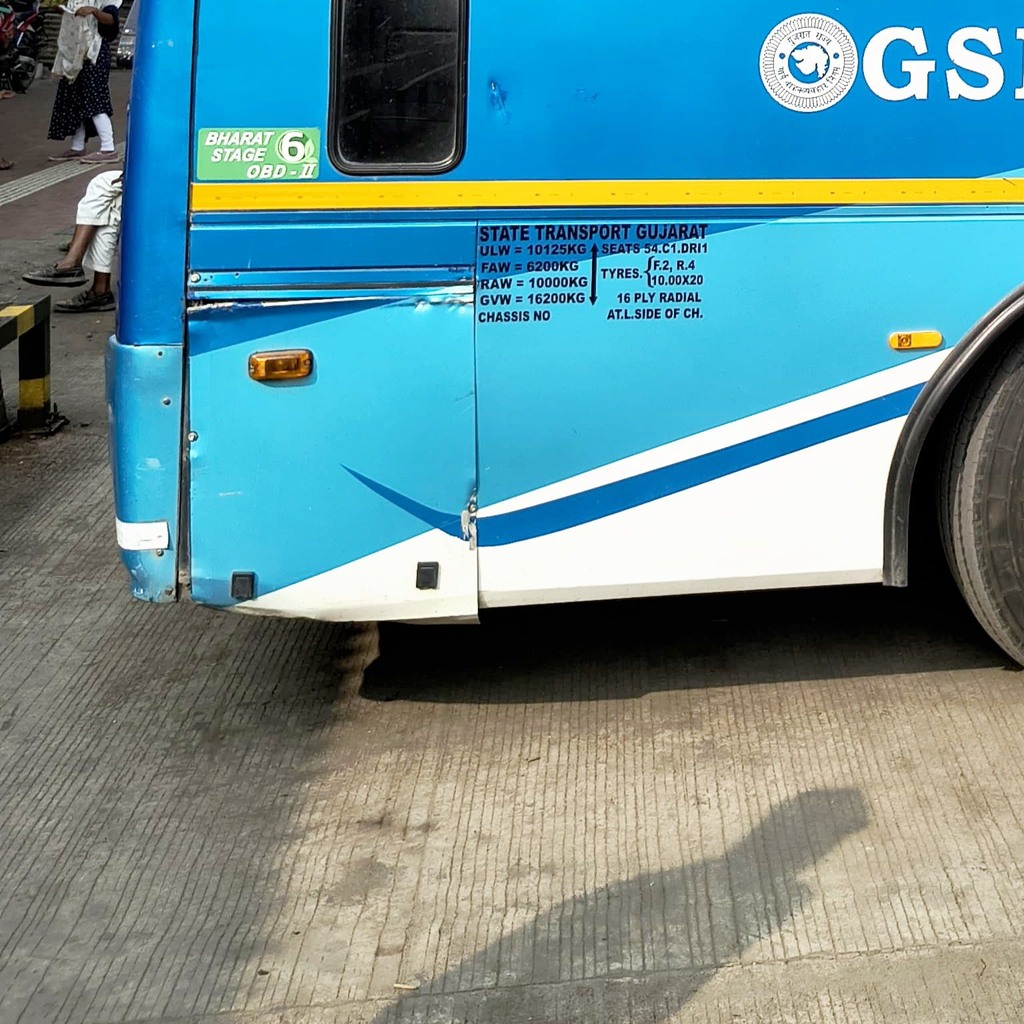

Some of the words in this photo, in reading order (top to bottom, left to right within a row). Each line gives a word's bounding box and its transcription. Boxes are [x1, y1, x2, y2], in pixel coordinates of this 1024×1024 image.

[205, 131, 275, 146] BHARAT
[280, 131, 305, 163] 6
[211, 147, 267, 163] STAGE
[246, 164, 287, 179] OBD
[479, 225, 530, 242] STATE
[535, 224, 631, 240] TRANSPORT
[636, 223, 709, 240] GUJARAT
[480, 244, 510, 256] ULW
[526, 243, 587, 256] 10125KG
[601, 243, 641, 255] SEATS
[481, 262, 511, 274] FAW
[526, 261, 579, 272] 6200KG
[676, 260, 696, 271] R.4
[601, 267, 643, 280] TYRES.
[652, 274, 704, 286] 10.00X20
[480, 278, 512, 290] RAW
[528, 277, 588, 289] 10000KG
[480, 294, 512, 306] GVW
[527, 292, 585, 304] 16200KG
[617, 293, 631, 304] 16
[634, 292, 657, 304] PLY
[659, 292, 702, 303] RADIAL
[478, 311, 530, 323] CHASSIS
[533, 310, 551, 321] NO
[664, 308, 681, 319] OF
[683, 307, 704, 319] CH.
